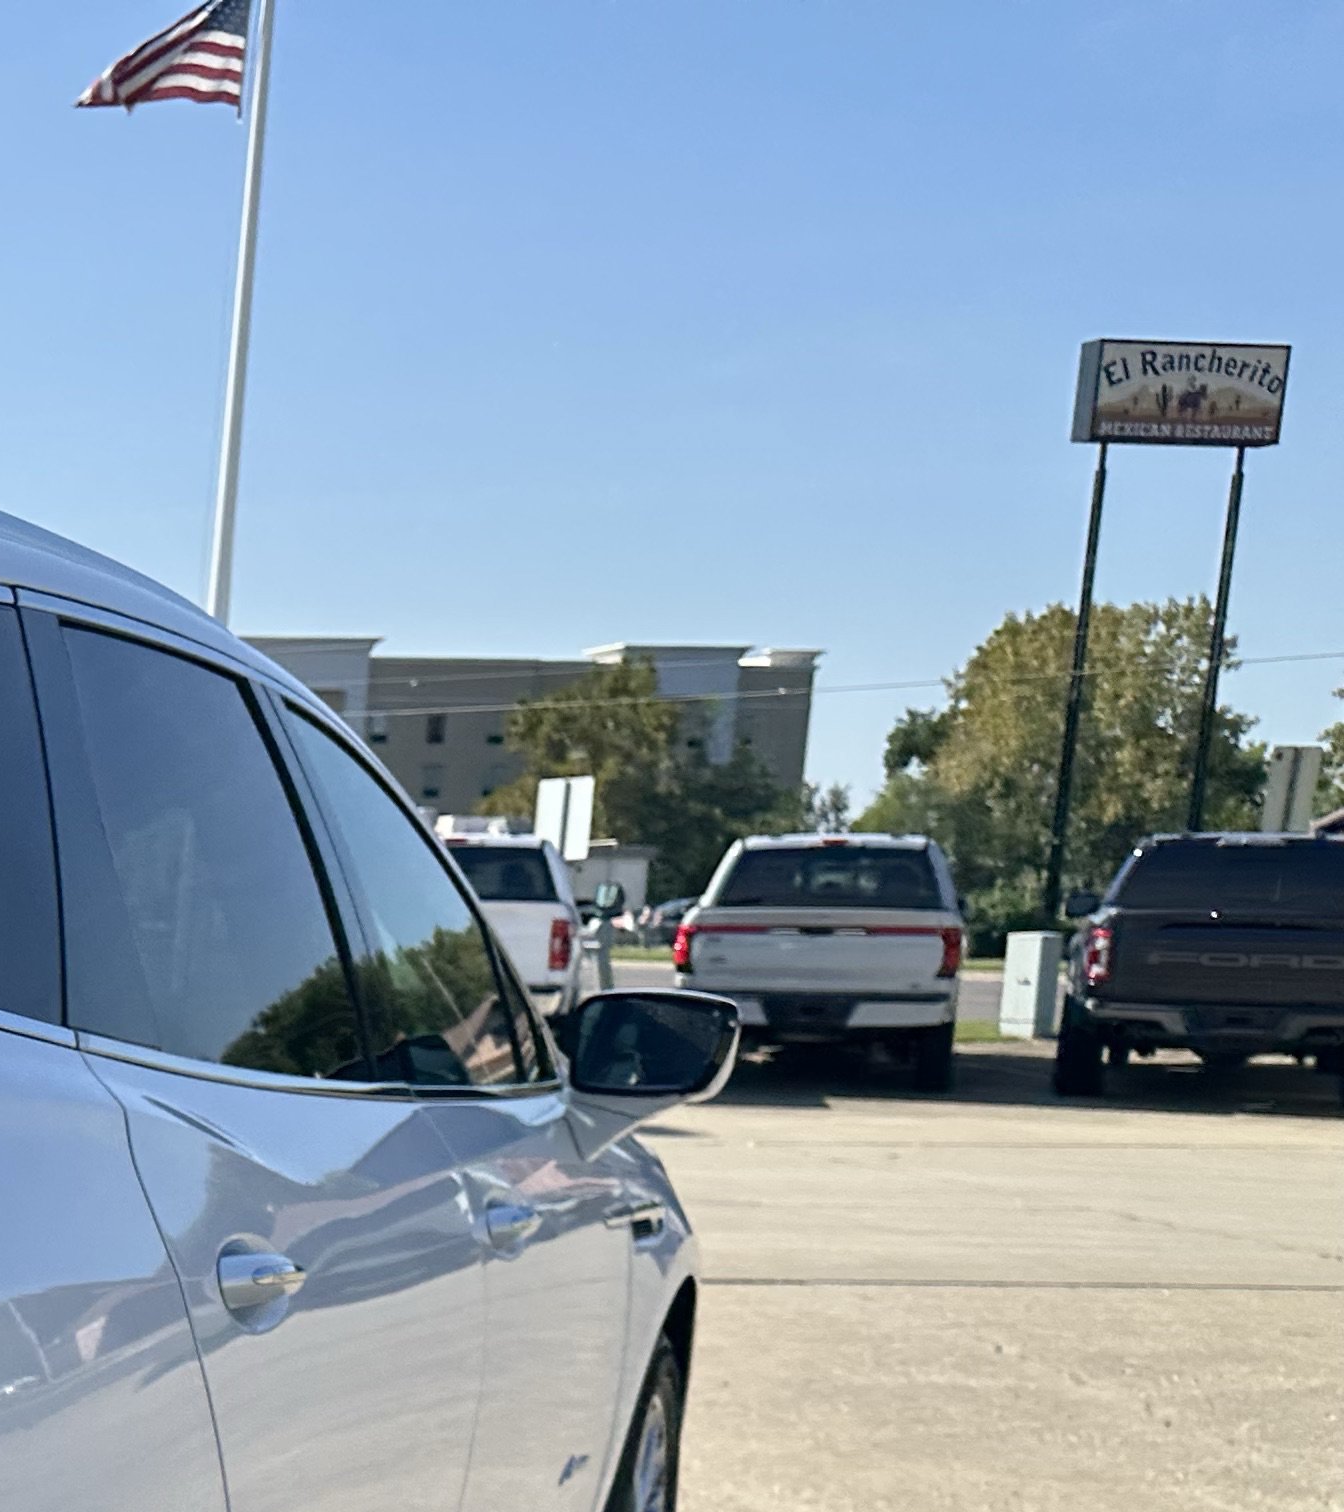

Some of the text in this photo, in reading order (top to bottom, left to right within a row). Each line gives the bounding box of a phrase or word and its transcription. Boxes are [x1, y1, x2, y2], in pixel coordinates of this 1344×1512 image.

[1102, 348, 1284, 395] El Rancherito
[1148, 951, 1344, 970] FORD
